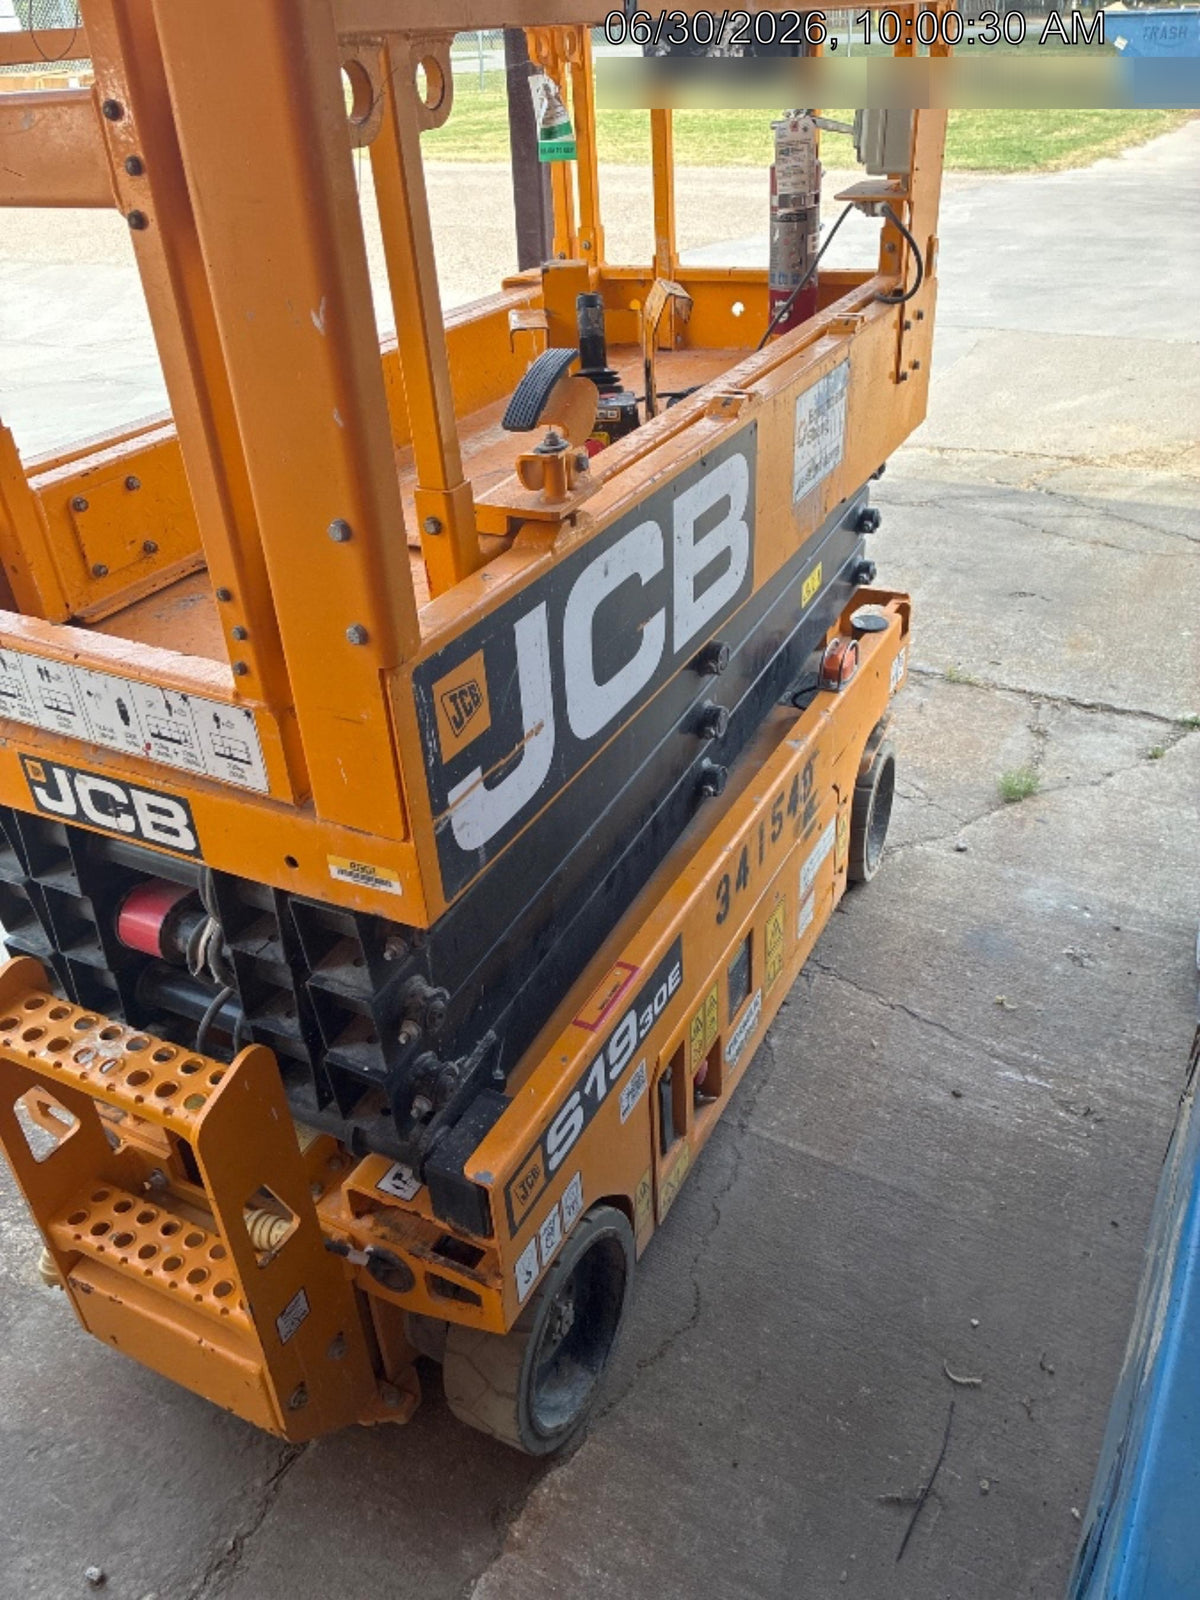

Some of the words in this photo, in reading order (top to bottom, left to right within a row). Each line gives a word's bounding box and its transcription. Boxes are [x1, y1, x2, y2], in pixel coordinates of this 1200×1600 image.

[1143, 25, 1188, 40] TRASH
[448, 452, 749, 851] JCB
[449, 684, 480, 729] JCB
[33, 767, 197, 851] JCB
[518, 1165, 540, 1201] JCB
